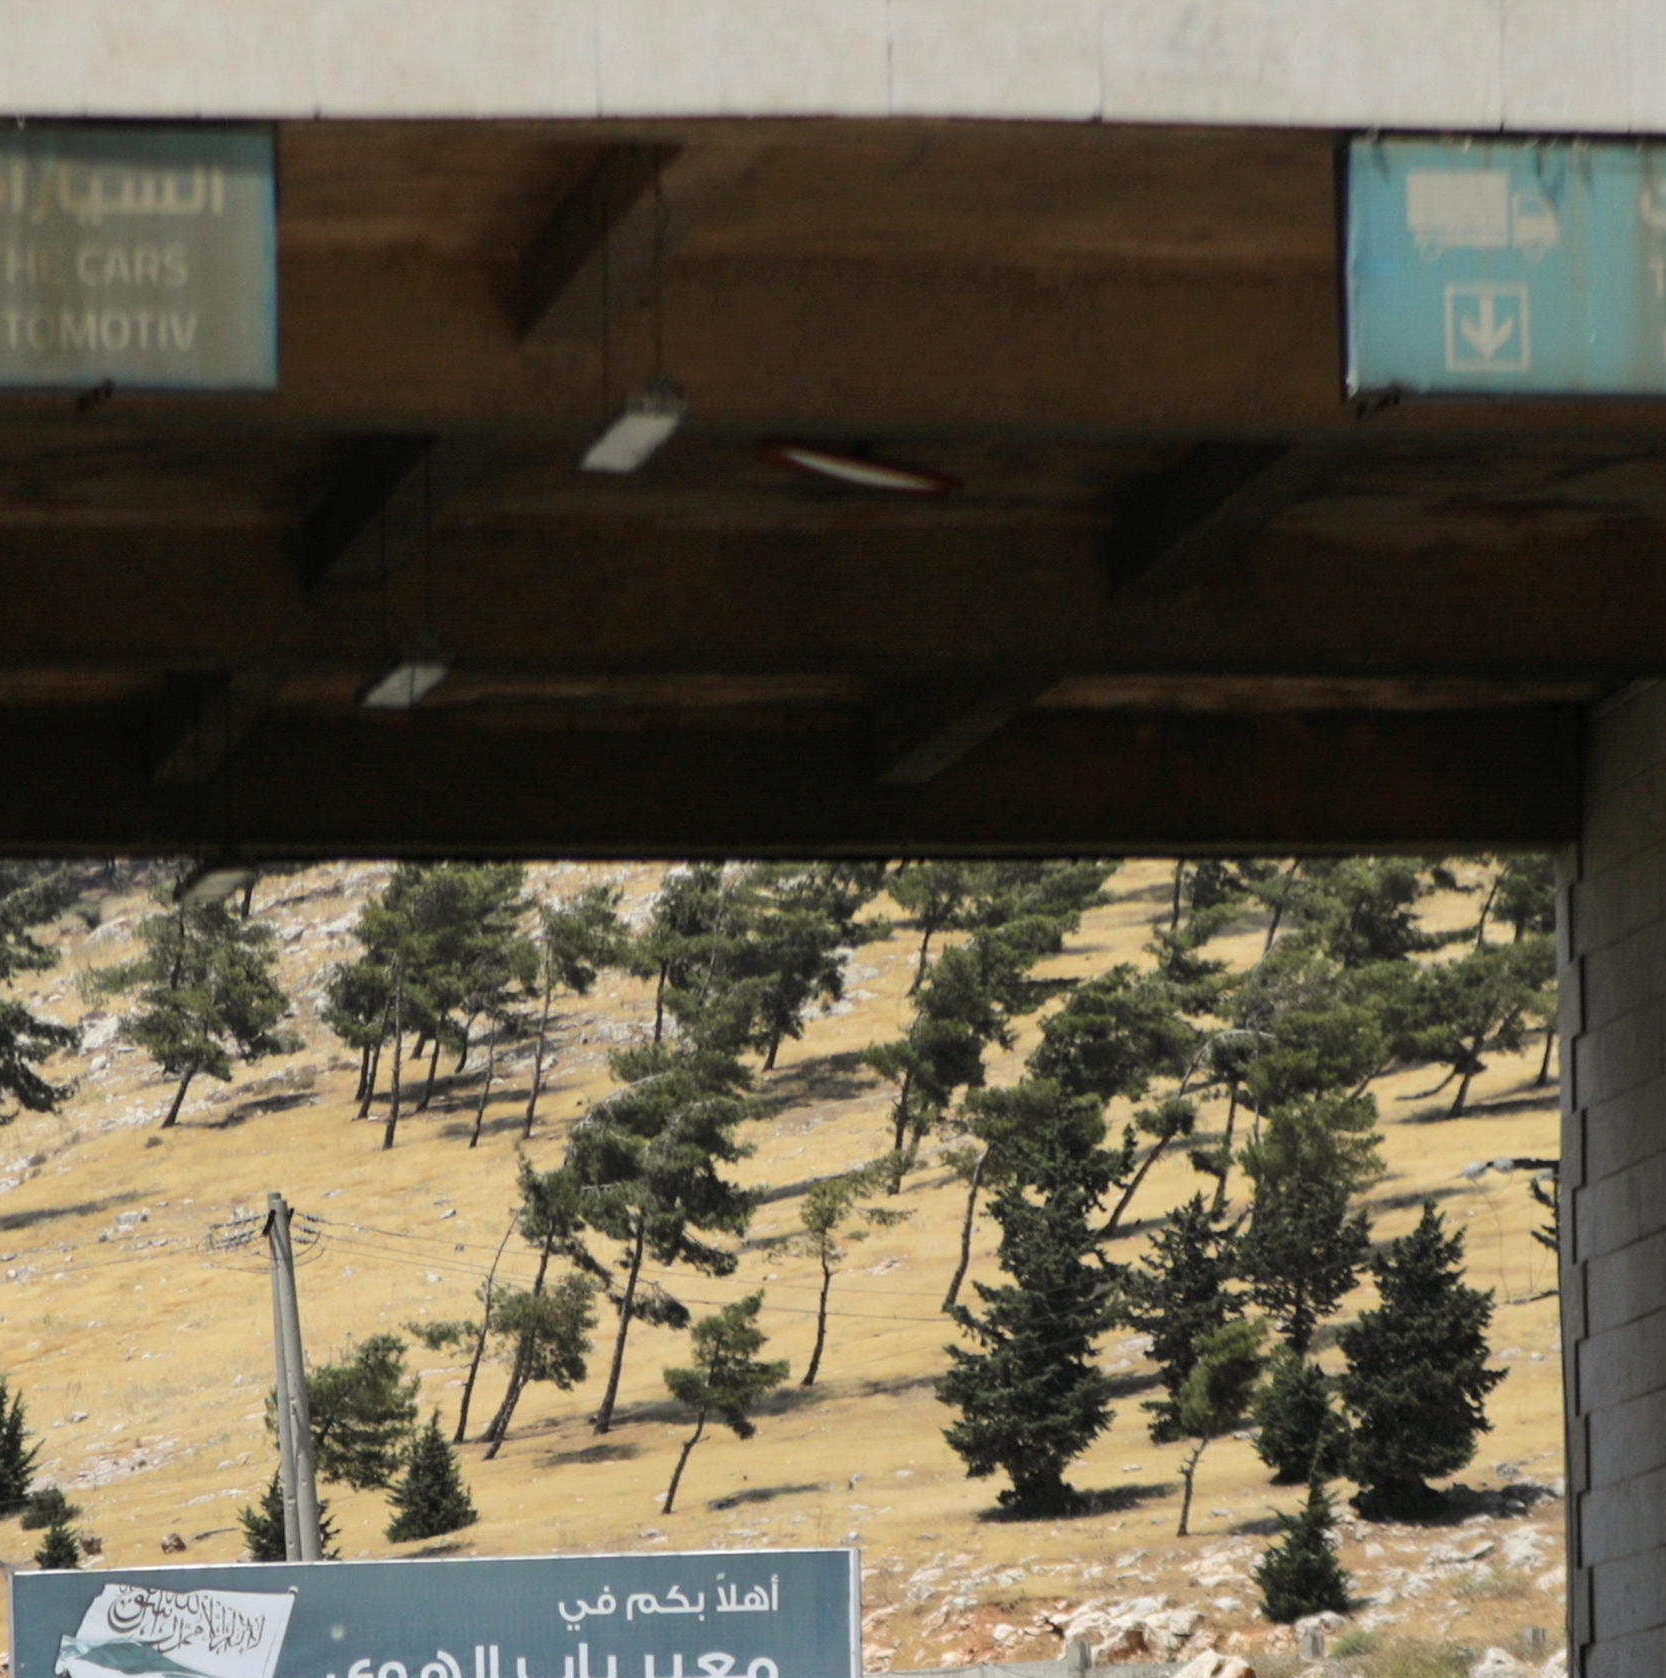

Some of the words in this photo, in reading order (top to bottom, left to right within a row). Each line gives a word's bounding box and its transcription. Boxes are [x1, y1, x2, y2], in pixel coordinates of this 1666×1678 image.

[76, 241, 189, 289] CARS
[558, 1584, 617, 1632] في
[626, 1584, 706, 1622] بكم
